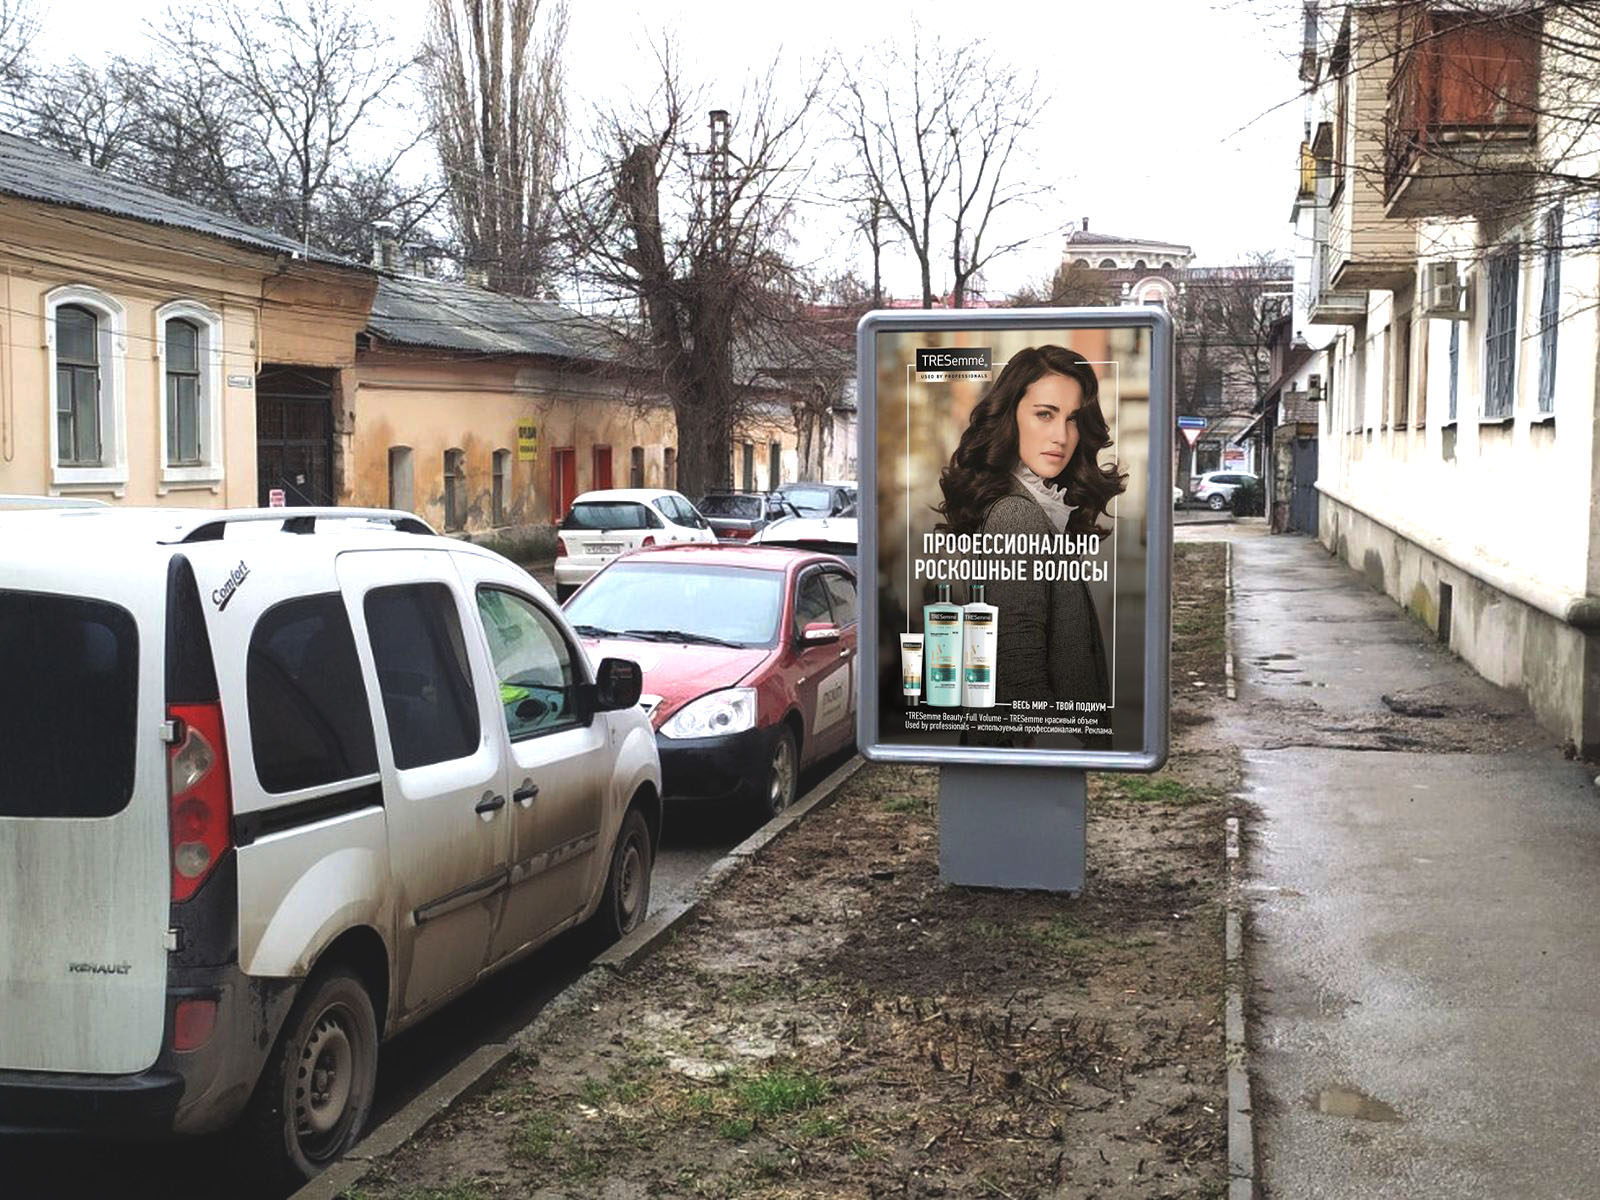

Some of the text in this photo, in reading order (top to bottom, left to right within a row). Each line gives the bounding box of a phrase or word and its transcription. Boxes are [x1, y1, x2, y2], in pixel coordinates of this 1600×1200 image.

[923, 533, 1100, 556] ПРОФЕССИОНАЛЬНО
[915, 559, 1108, 582] РОСКОШНЫЕ ВОЛОСЫ
[212, 560, 249, 607] Comfort
[1012, 700, 1030, 710] ВЕСЬ
[1032, 701, 1048, 710] МИР
[1056, 700, 1074, 710] ТВОЙ
[1076, 702, 1106, 712] ПОДИУМ
[905, 721, 920, 729] Used
[921, 721, 928, 731] by
[929, 721, 970, 731] professionals
[977, 724, 1023, 733] используемый
[1084, 726, 1114, 735] Реклама.
[979, 713, 1002, 722] Volume
[1045, 716, 1076, 725] красивый
